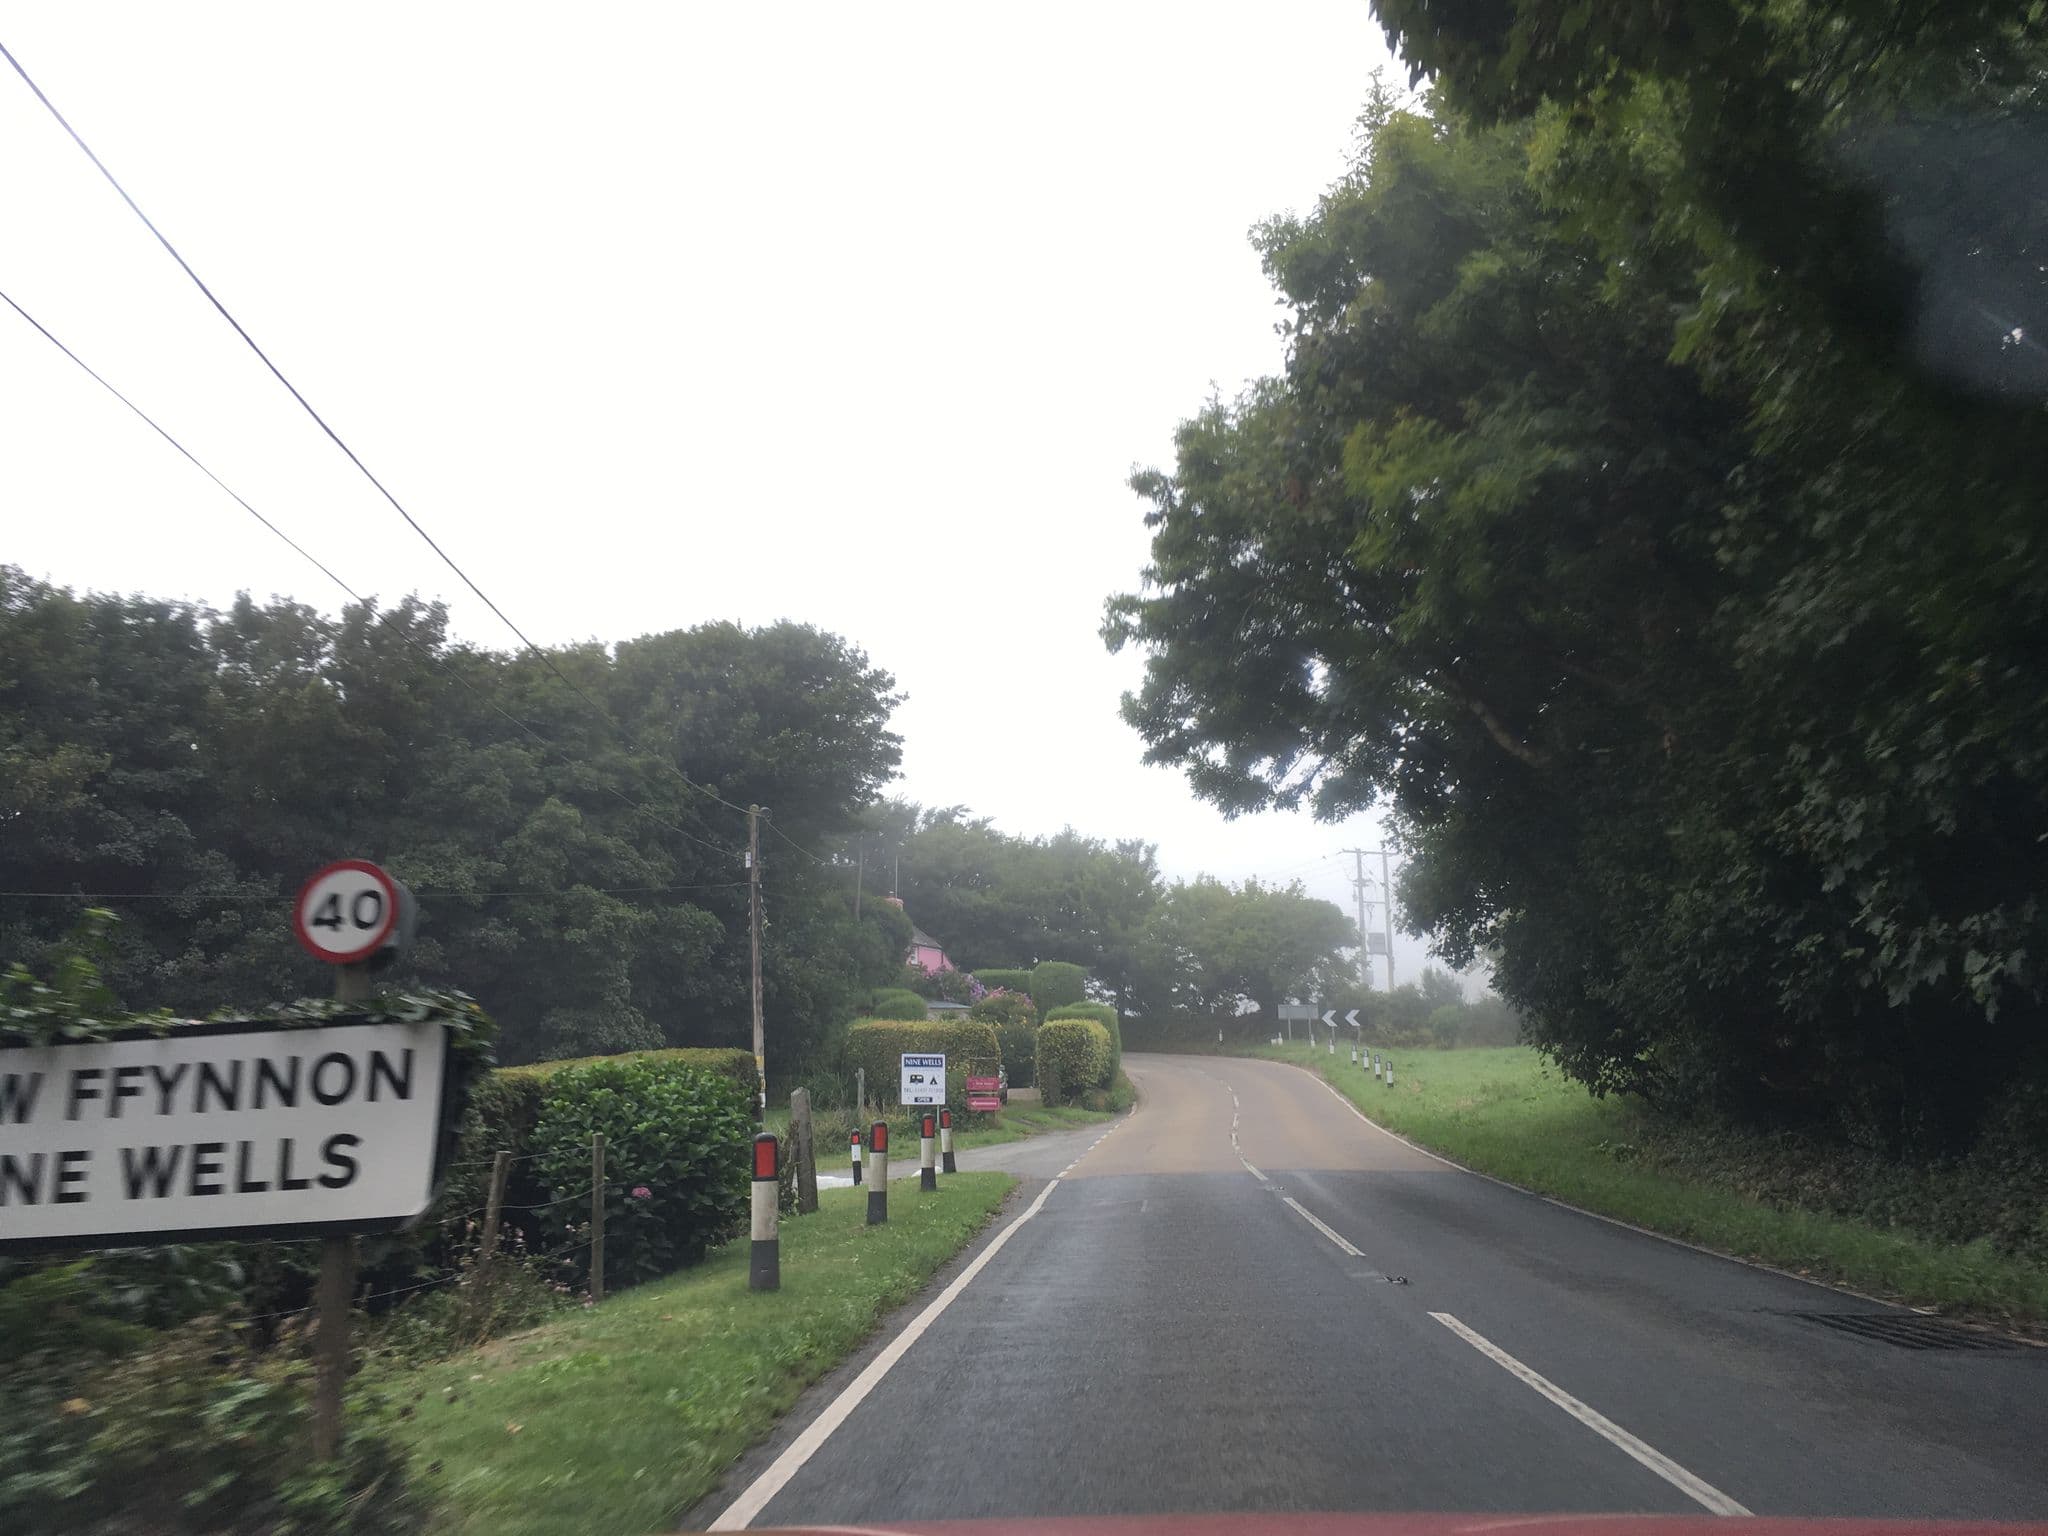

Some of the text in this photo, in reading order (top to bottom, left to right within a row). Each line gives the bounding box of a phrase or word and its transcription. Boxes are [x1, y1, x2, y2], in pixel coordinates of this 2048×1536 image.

[310, 889, 384, 931] 40
[64, 1048, 415, 1121] FFYNNON
[0, 1133, 364, 1207] NE WELLS
